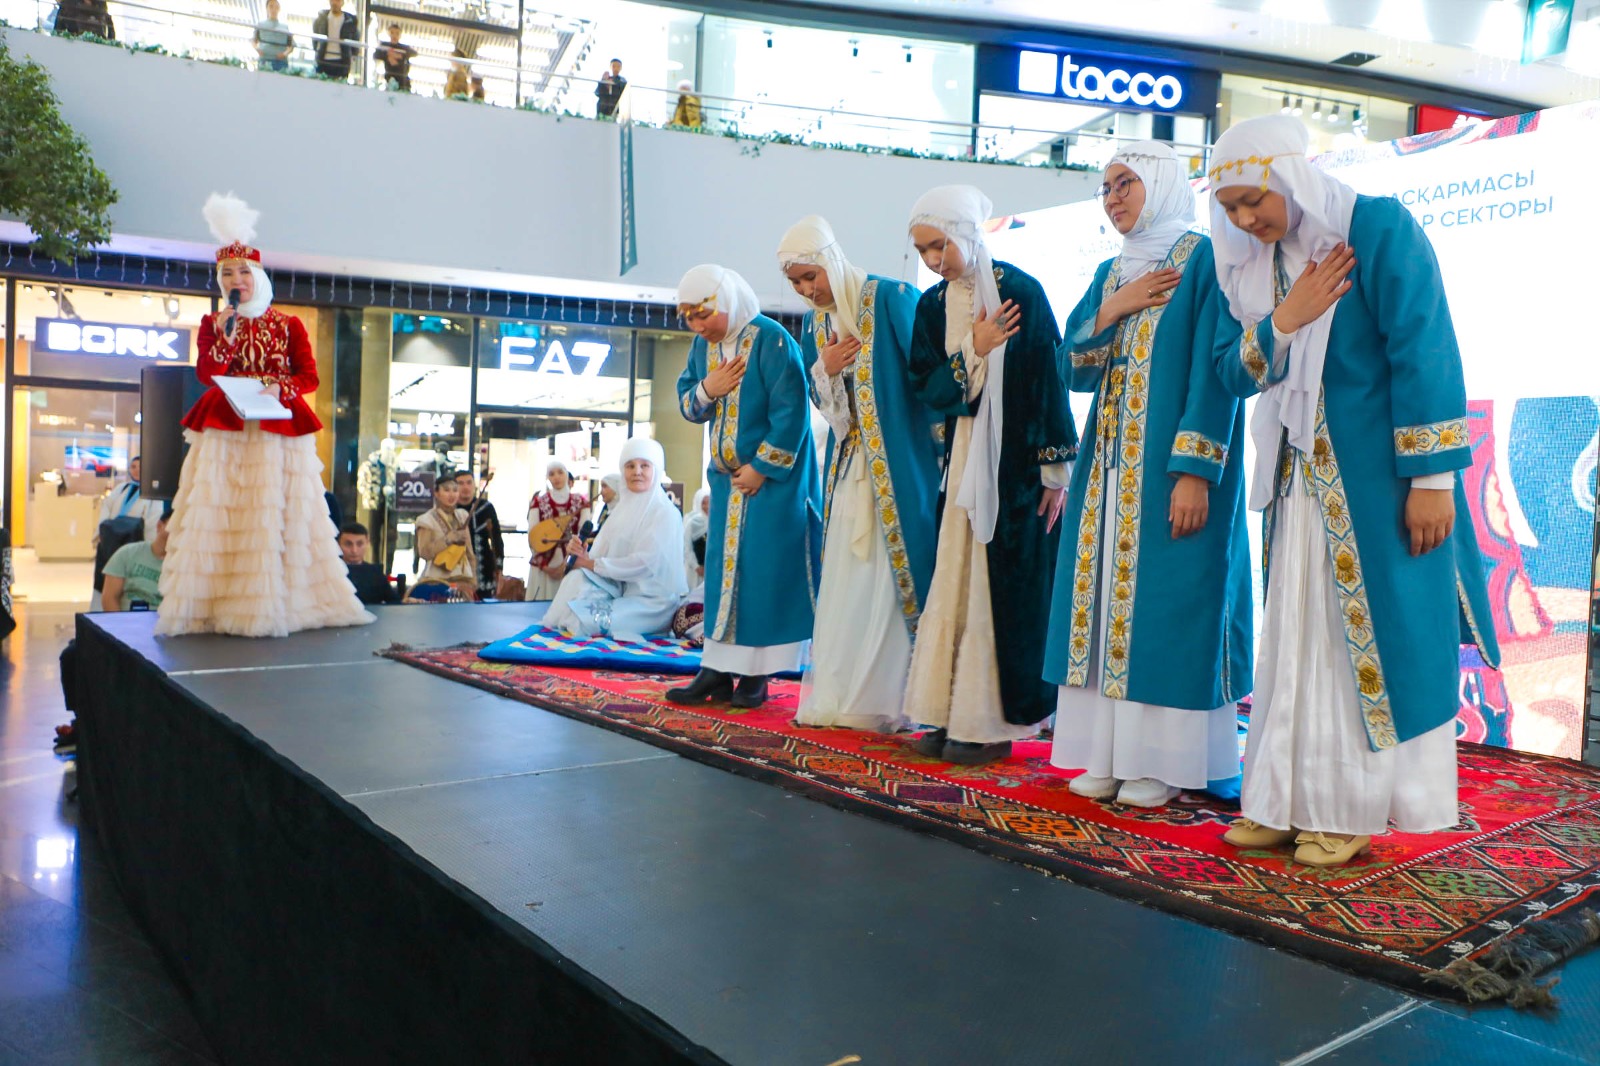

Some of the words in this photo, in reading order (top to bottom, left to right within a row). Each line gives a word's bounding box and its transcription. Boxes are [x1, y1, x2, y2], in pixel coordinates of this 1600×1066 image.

[1061, 54, 1183, 109] tacco
[1381, 169, 1535, 207] СҚАРМАСЫ
[1440, 196, 1554, 228] СЕКТОРЫ
[48, 321, 179, 360] BORK
[500, 336, 612, 379] EA7
